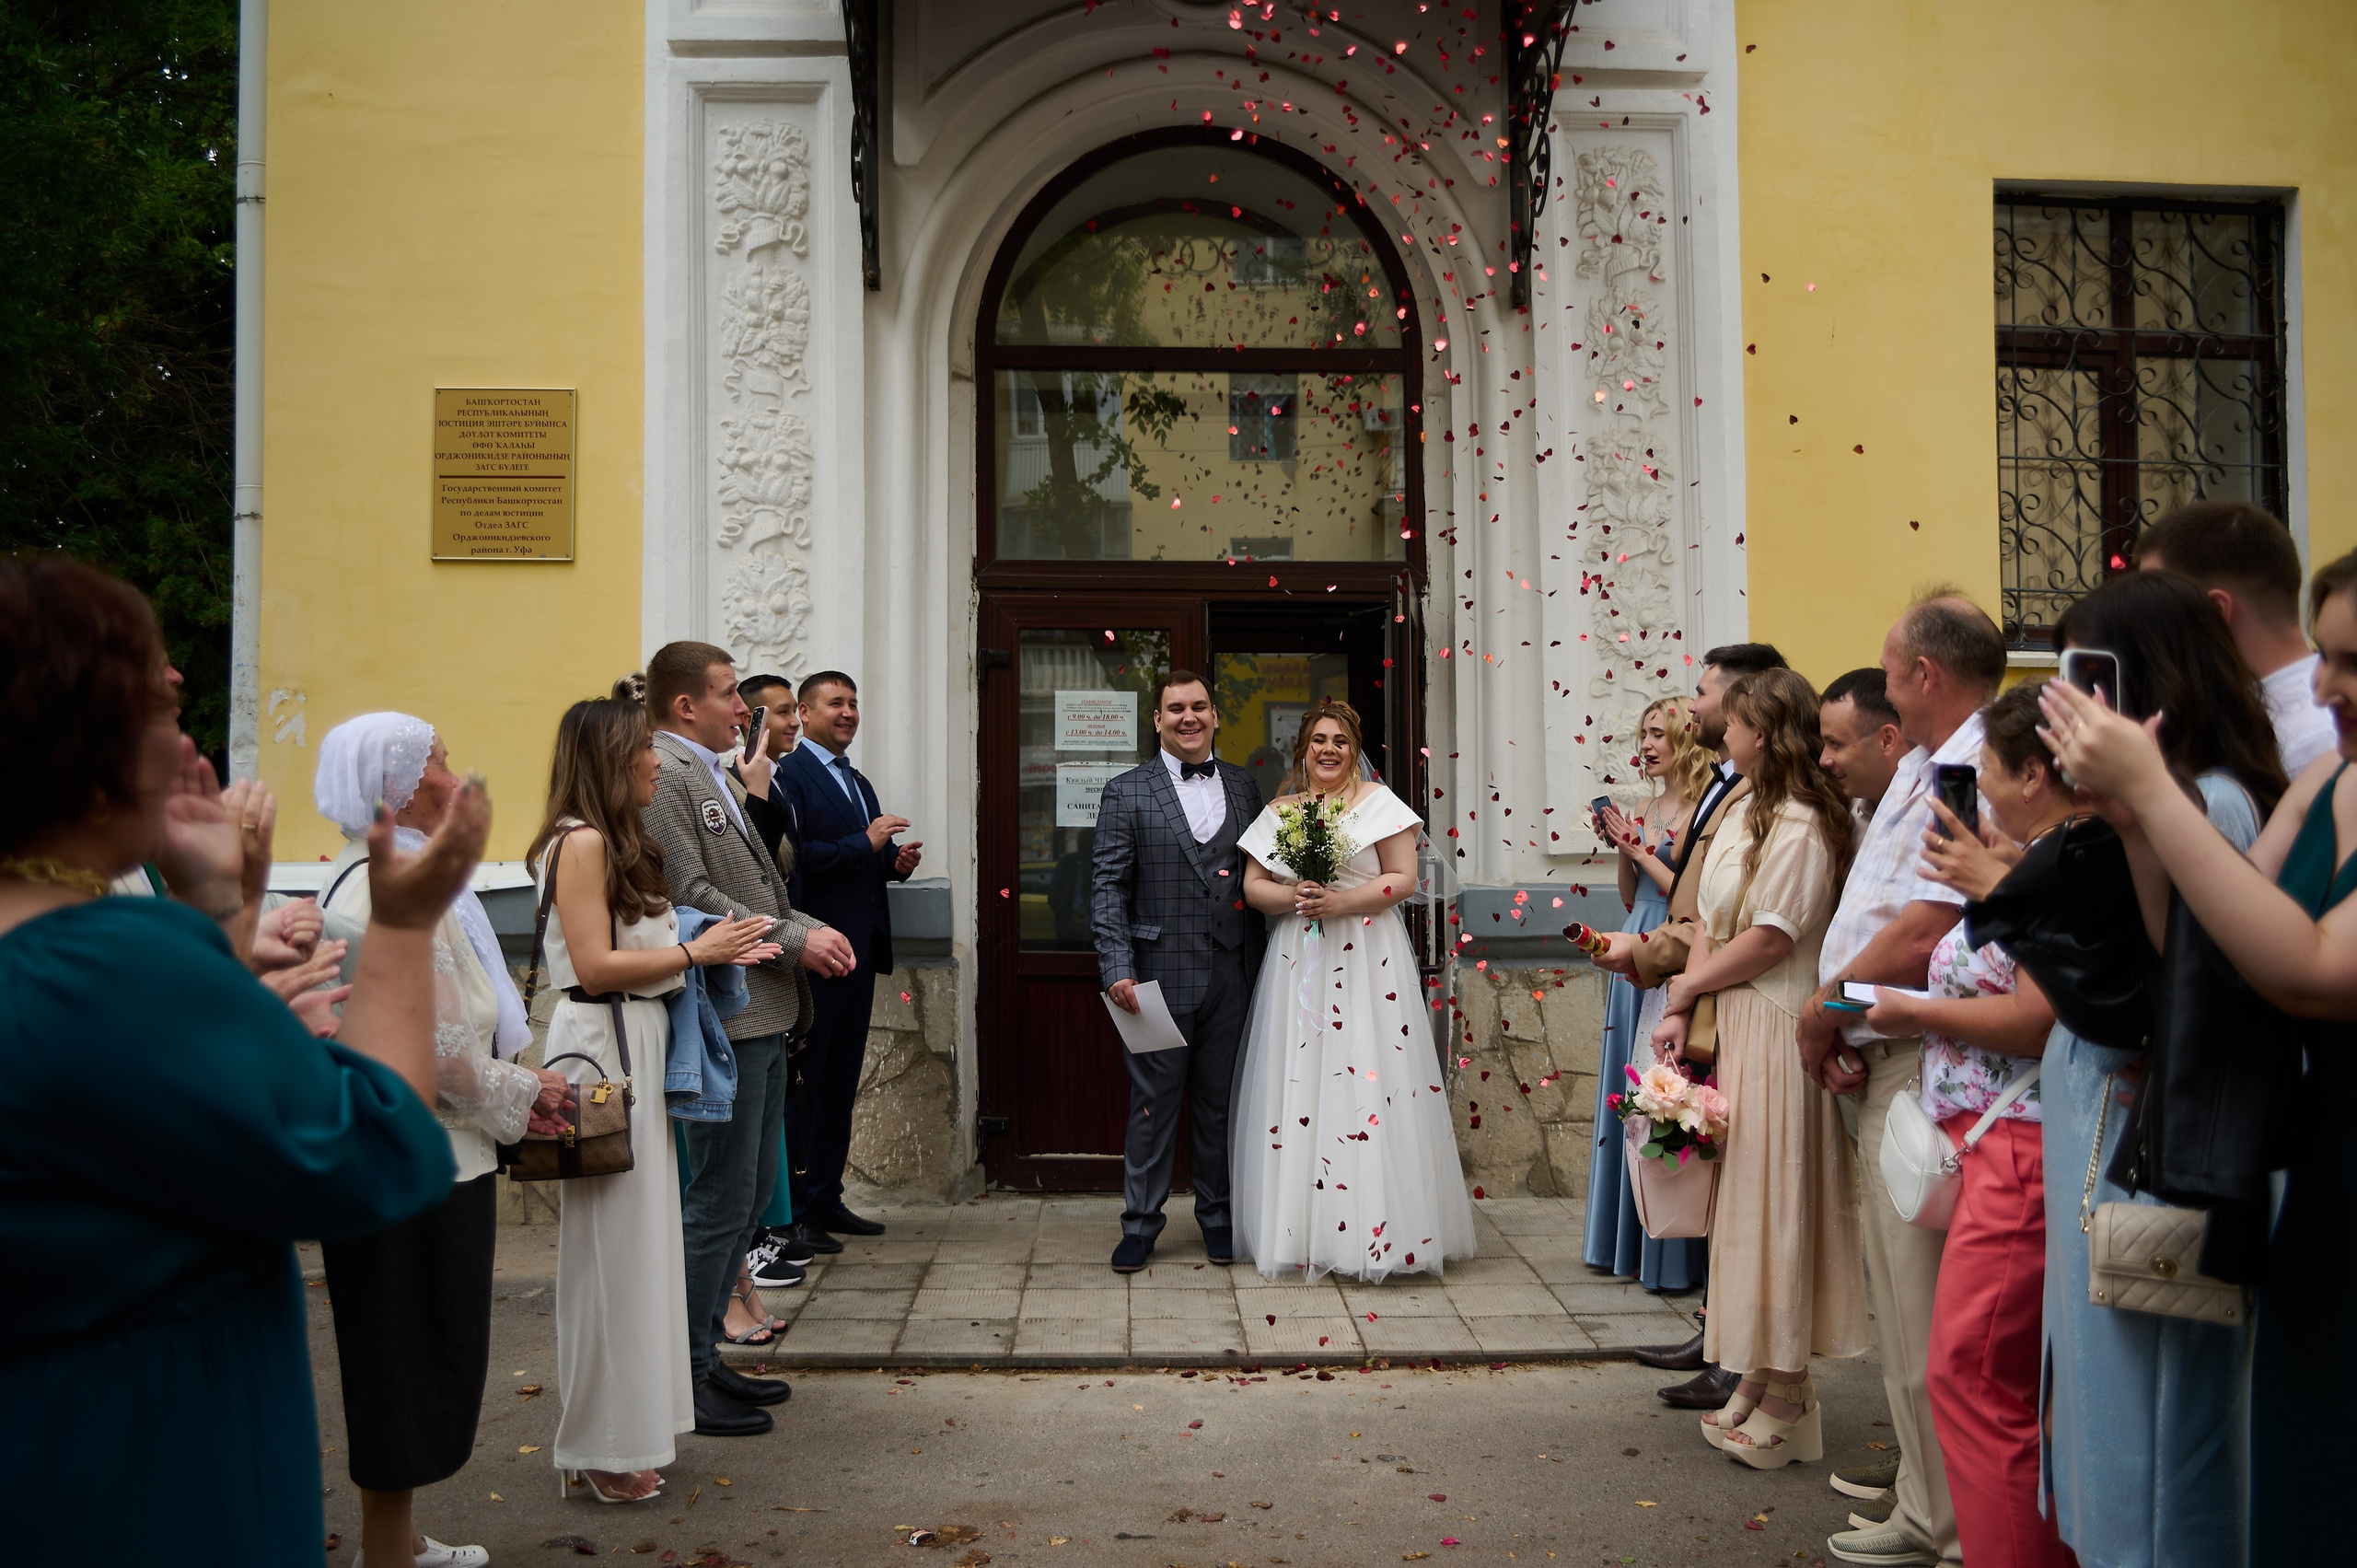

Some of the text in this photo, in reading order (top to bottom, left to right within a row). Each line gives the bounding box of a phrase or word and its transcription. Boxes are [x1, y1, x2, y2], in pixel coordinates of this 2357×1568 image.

[524, 420, 567, 428] БУЙЫНСА
[435, 452, 571, 460] ОРДЖОНИКИДЗЕ РАЙОНЫНЫҢ
[442, 484, 522, 494] Государственный
[441, 496, 563, 505] Республики Башкортостан
[475, 521, 503, 529] Отдел
[452, 533, 551, 542] Орджоникидзевского
[470, 546, 504, 555] района
[514, 546, 532, 555] Уфа
